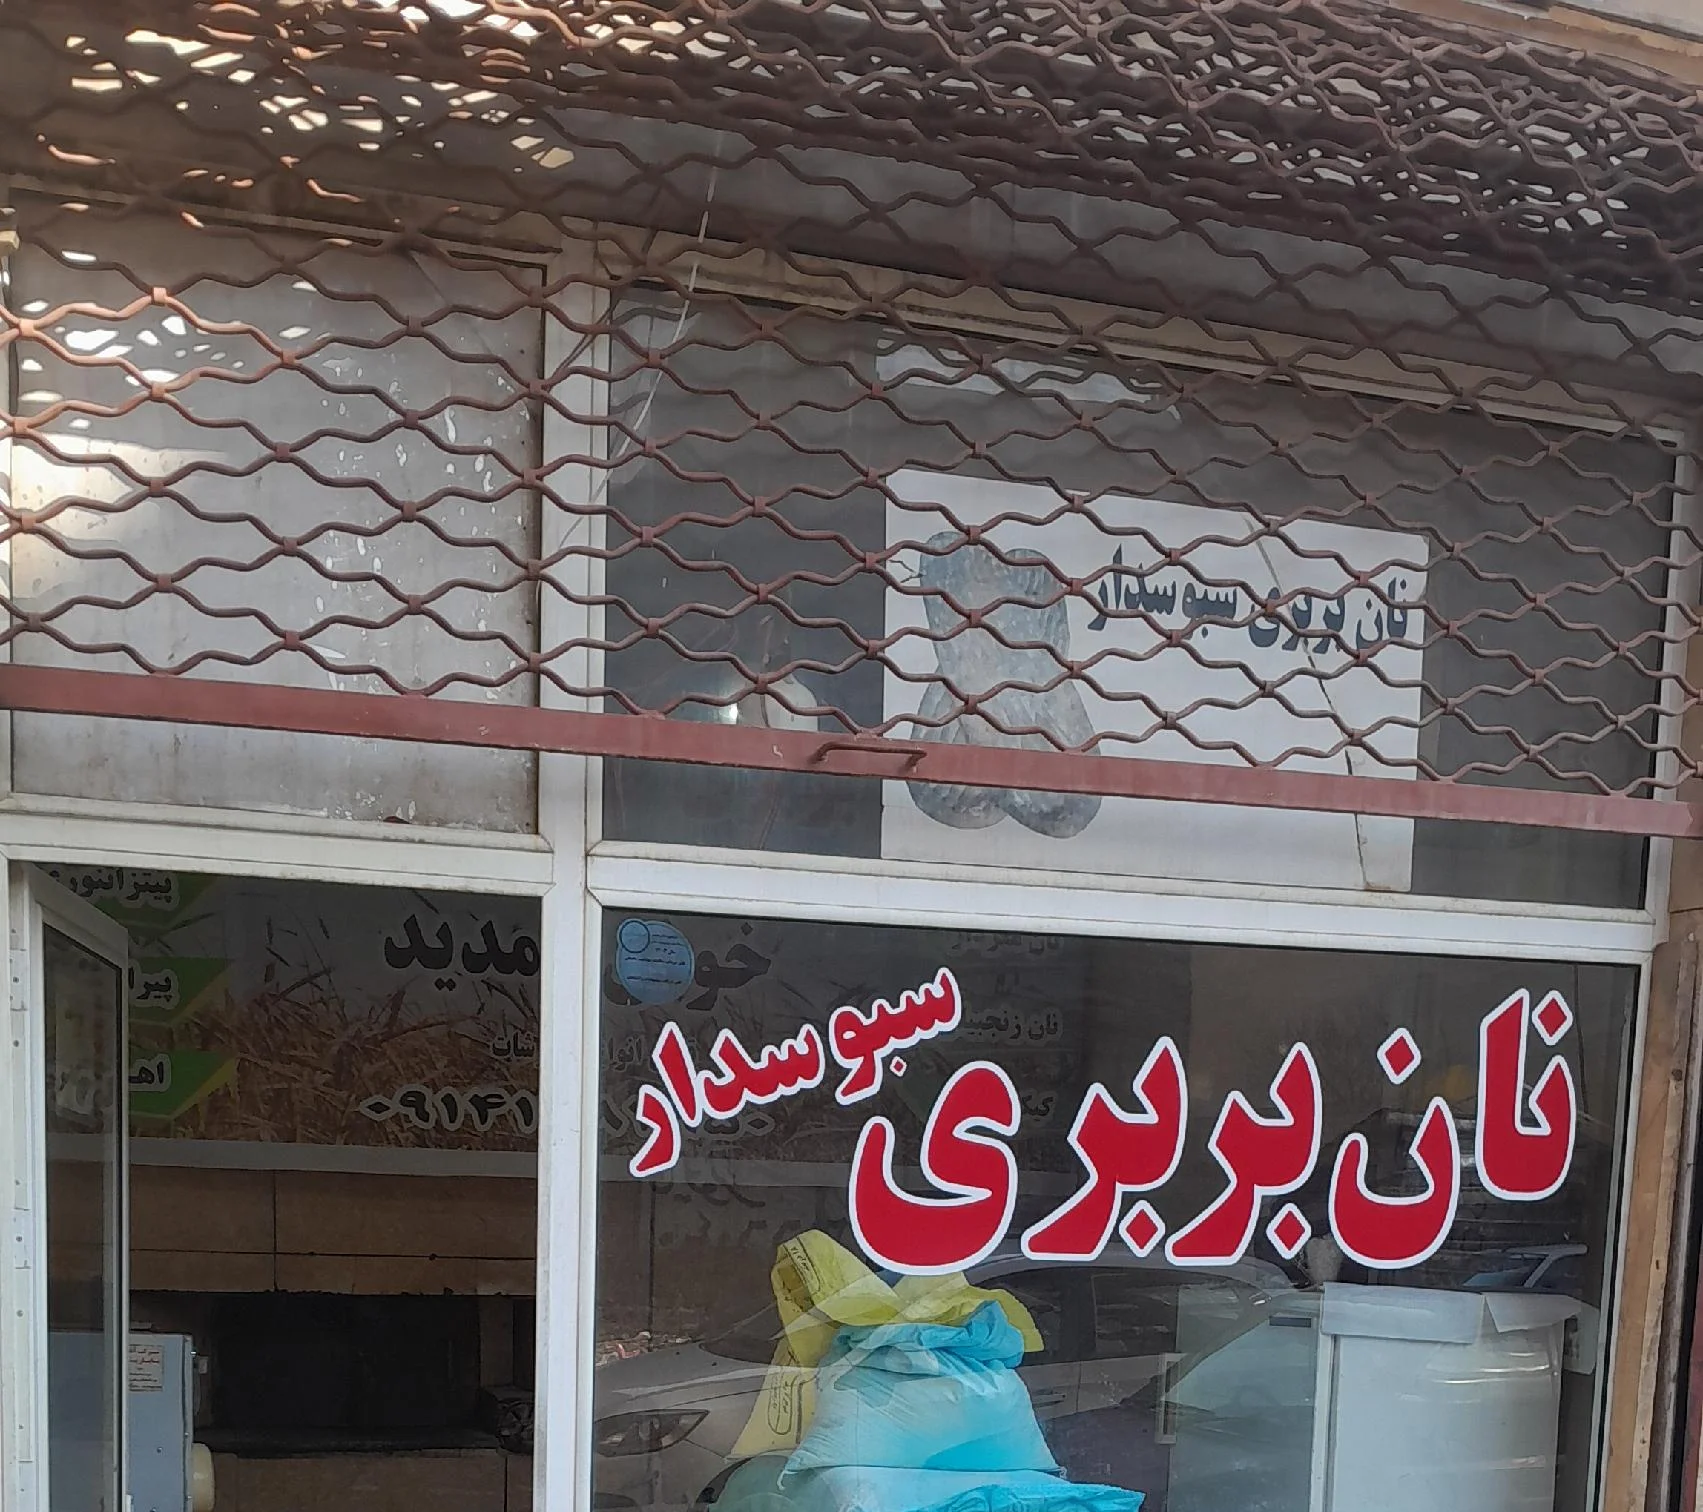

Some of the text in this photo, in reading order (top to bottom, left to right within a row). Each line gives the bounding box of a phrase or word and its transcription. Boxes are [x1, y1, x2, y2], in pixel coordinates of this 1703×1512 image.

[1356, 577, 1408, 651] نان
[383, 914, 540, 992] مدید
[848, 987, 1576, 1276] نان بربری
